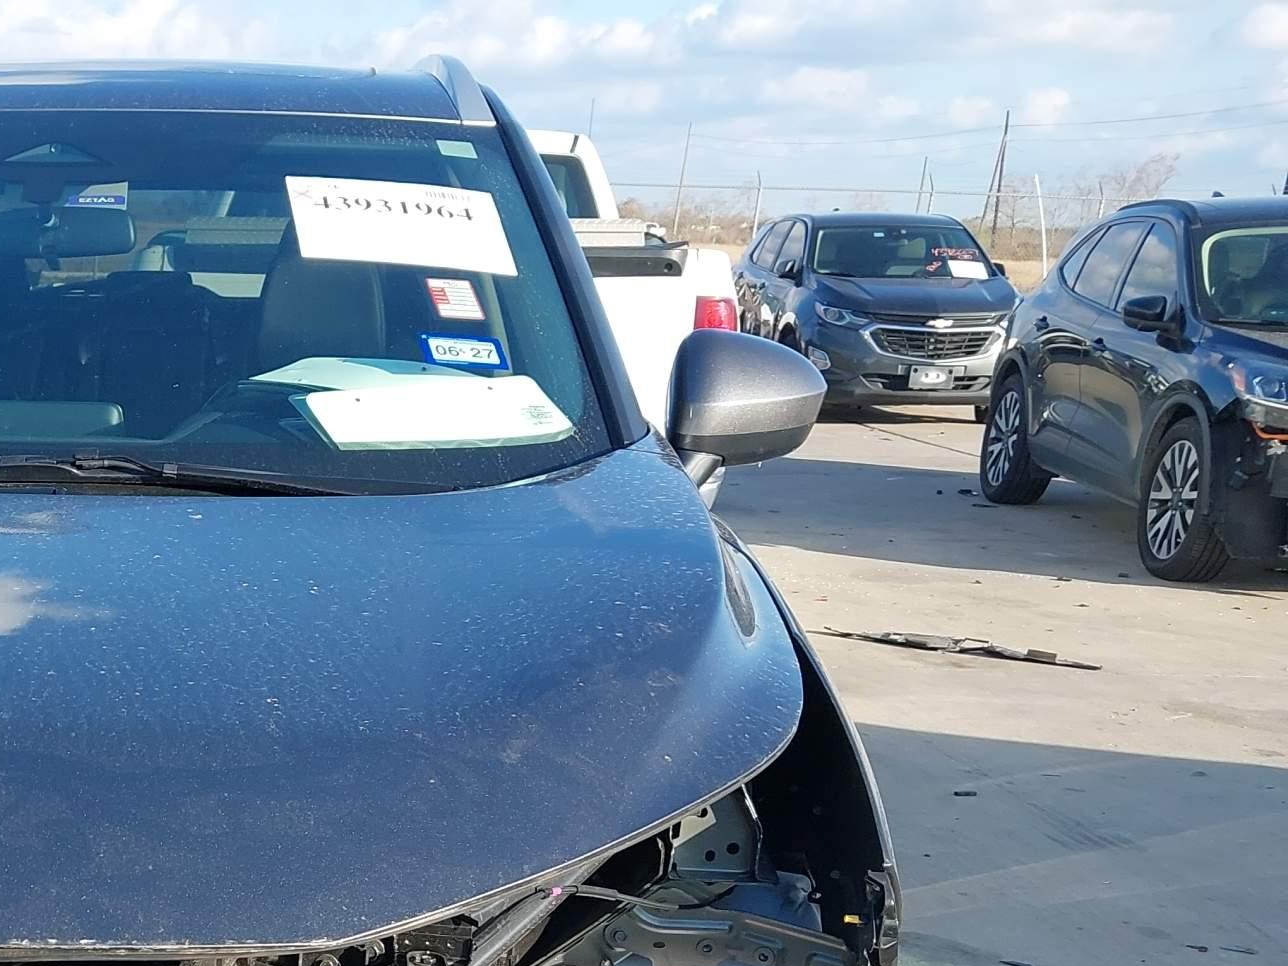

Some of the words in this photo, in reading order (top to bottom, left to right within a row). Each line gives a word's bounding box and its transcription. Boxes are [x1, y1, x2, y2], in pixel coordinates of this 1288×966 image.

[314, 195, 474, 221] 43931964
[435, 344, 460, 357] 06
[470, 347, 493, 359] 27
